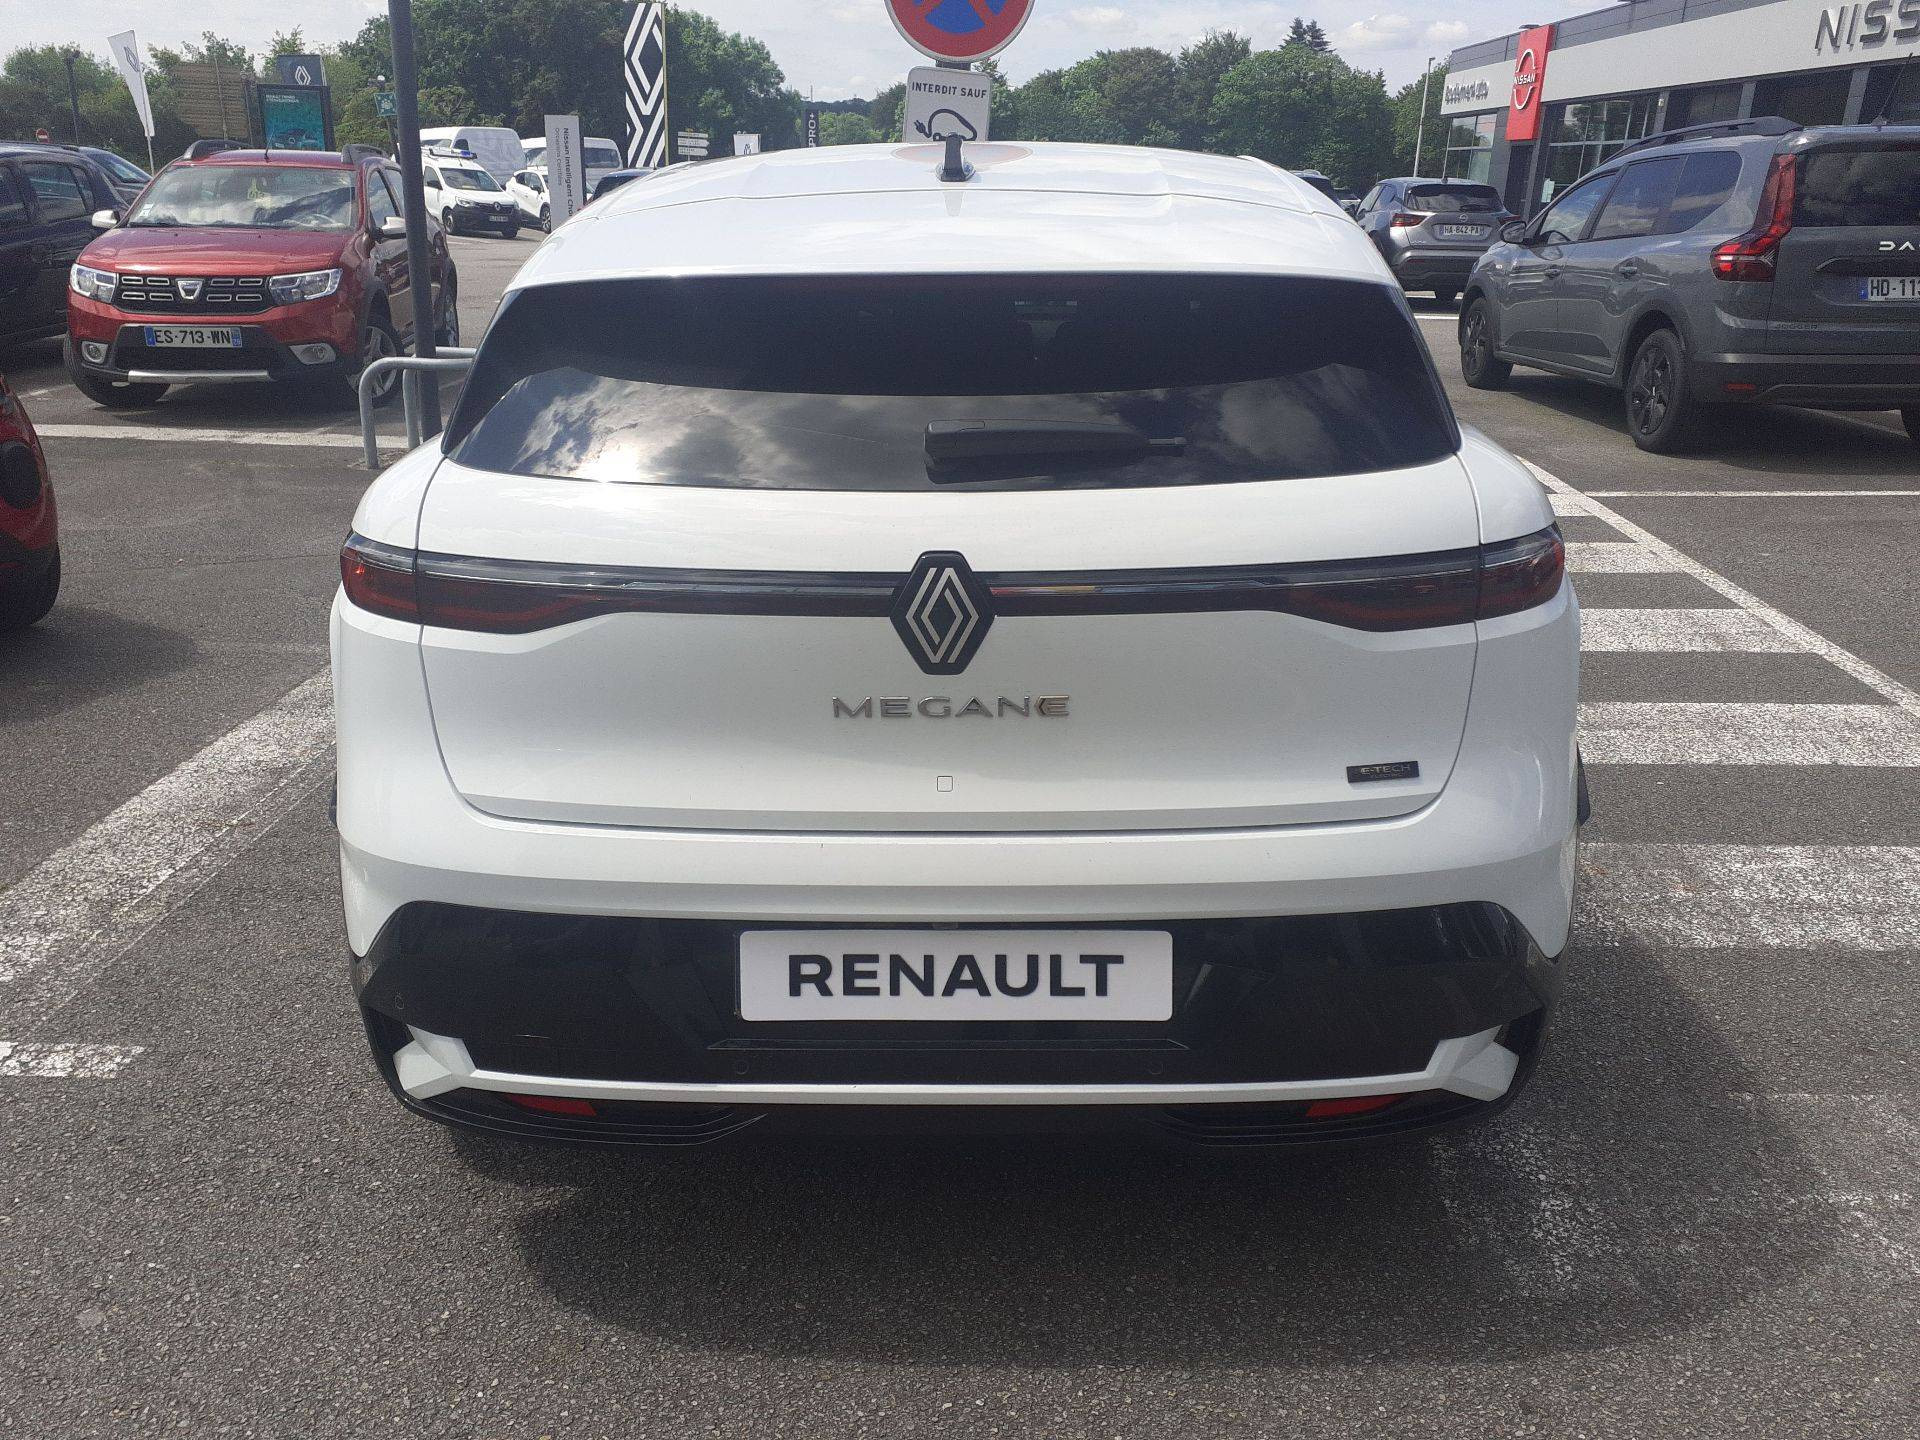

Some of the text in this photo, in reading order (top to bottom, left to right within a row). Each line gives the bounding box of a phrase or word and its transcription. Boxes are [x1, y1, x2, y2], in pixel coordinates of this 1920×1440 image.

[1814, 0, 1920, 51] NISS
[1513, 72, 1536, 84] NISSAN
[912, 81, 987, 98] INTERDIT SAUF
[564, 156, 573, 198] Intelligent
[155, 329, 231, 345] ES-713-WN
[832, 695, 1070, 718] MEGANE
[1360, 764, 1411, 775] E-TECH
[789, 953, 1124, 997] RENAULT
